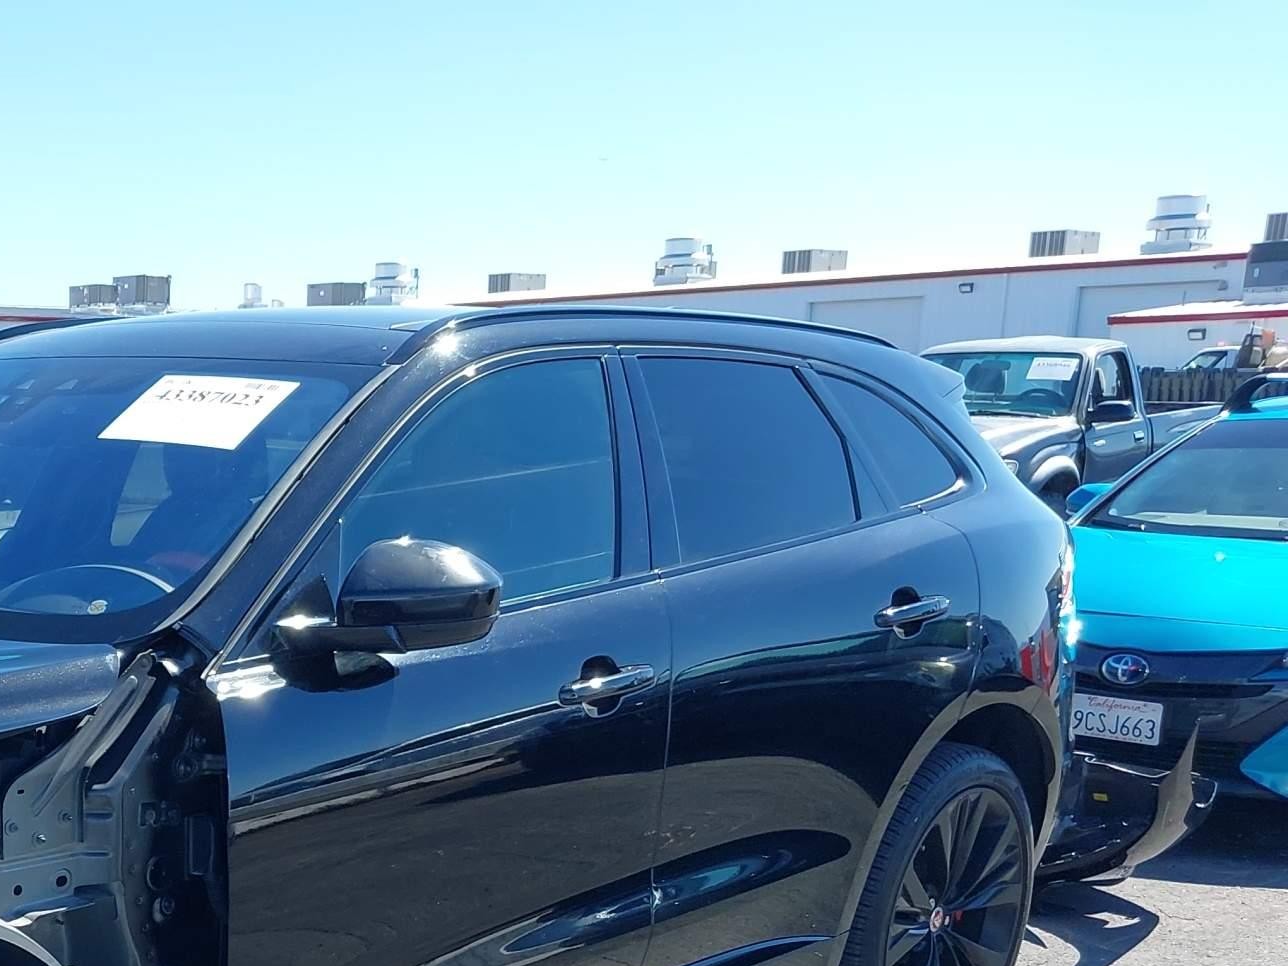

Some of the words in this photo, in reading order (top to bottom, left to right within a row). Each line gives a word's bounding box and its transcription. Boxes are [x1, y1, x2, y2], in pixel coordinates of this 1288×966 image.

[153, 389, 264, 406] 43387023
[1088, 697, 1147, 712] California
[1072, 710, 1156, 740] 9CSJ663
